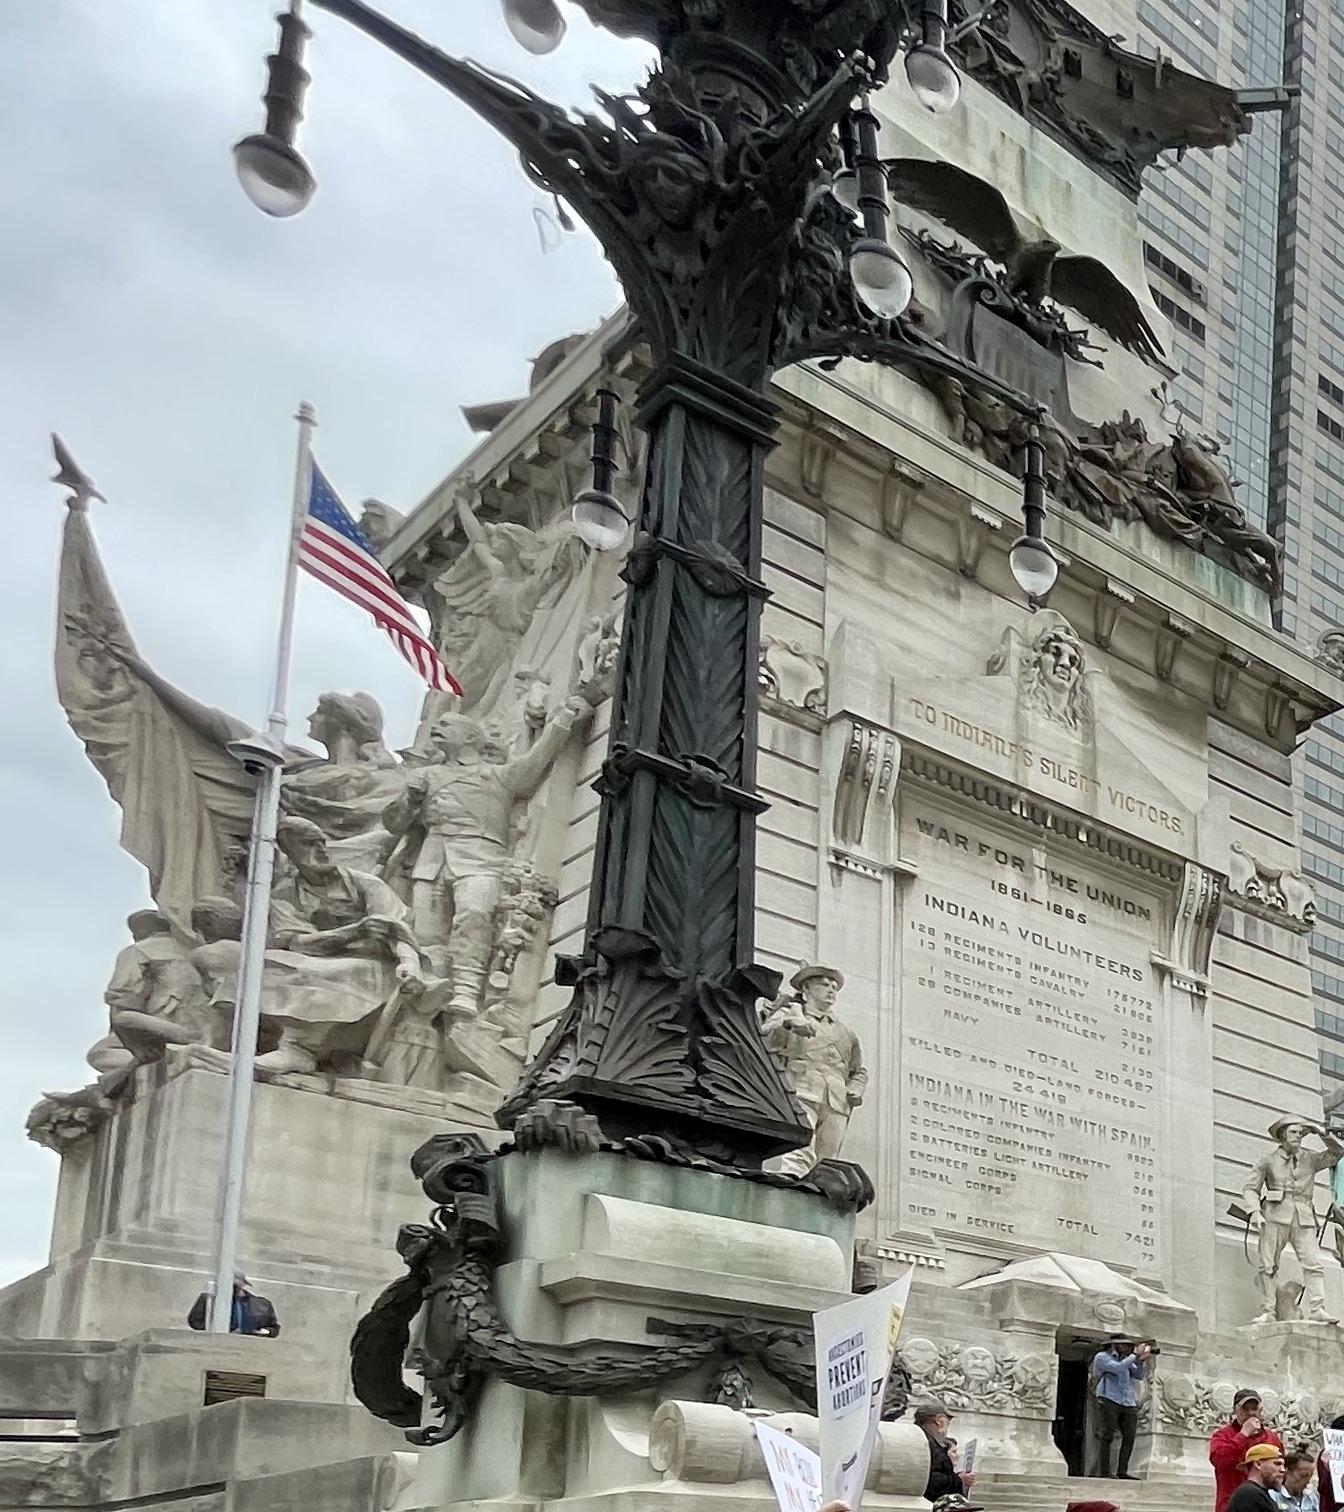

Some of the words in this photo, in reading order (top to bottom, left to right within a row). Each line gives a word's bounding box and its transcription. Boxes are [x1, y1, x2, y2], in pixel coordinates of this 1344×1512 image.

[910, 699, 936, 726] TO
[916, 817, 968, 851] WAR
[978, 842, 1025, 872] FOR
[1033, 865, 1079, 894] THE
[1086, 884, 1151, 922] UNION
[924, 893, 1010, 935] INDIANA
[1018, 926, 1143, 982] VOLUNTEERS
[944, 932, 1021, 965] REGIMENTS
[1029, 961, 1090, 988] INFANTRY
[944, 947, 1021, 979] REGIMENTS
[1030, 975, 1086, 998] CAVALRY
[1028, 997, 1098, 1026] ARTILLERY
[1036, 1014, 1106, 1042] ARTILLERY
[1027, 1048, 1079, 1074] TOTAL
[909, 1073, 974, 1106] INDIANA
[979, 1091, 994, 1107] IN
[999, 1097, 1029, 1118] THE
[1034, 1106, 1066, 1128] WAR
[1070, 1116, 1107, 1139] WITH
[1032, 1161, 1089, 1181] ARTILLERY
[1057, 1217, 1099, 1235] TOTAL
[828, 1350, 866, 1390] PREVENT
